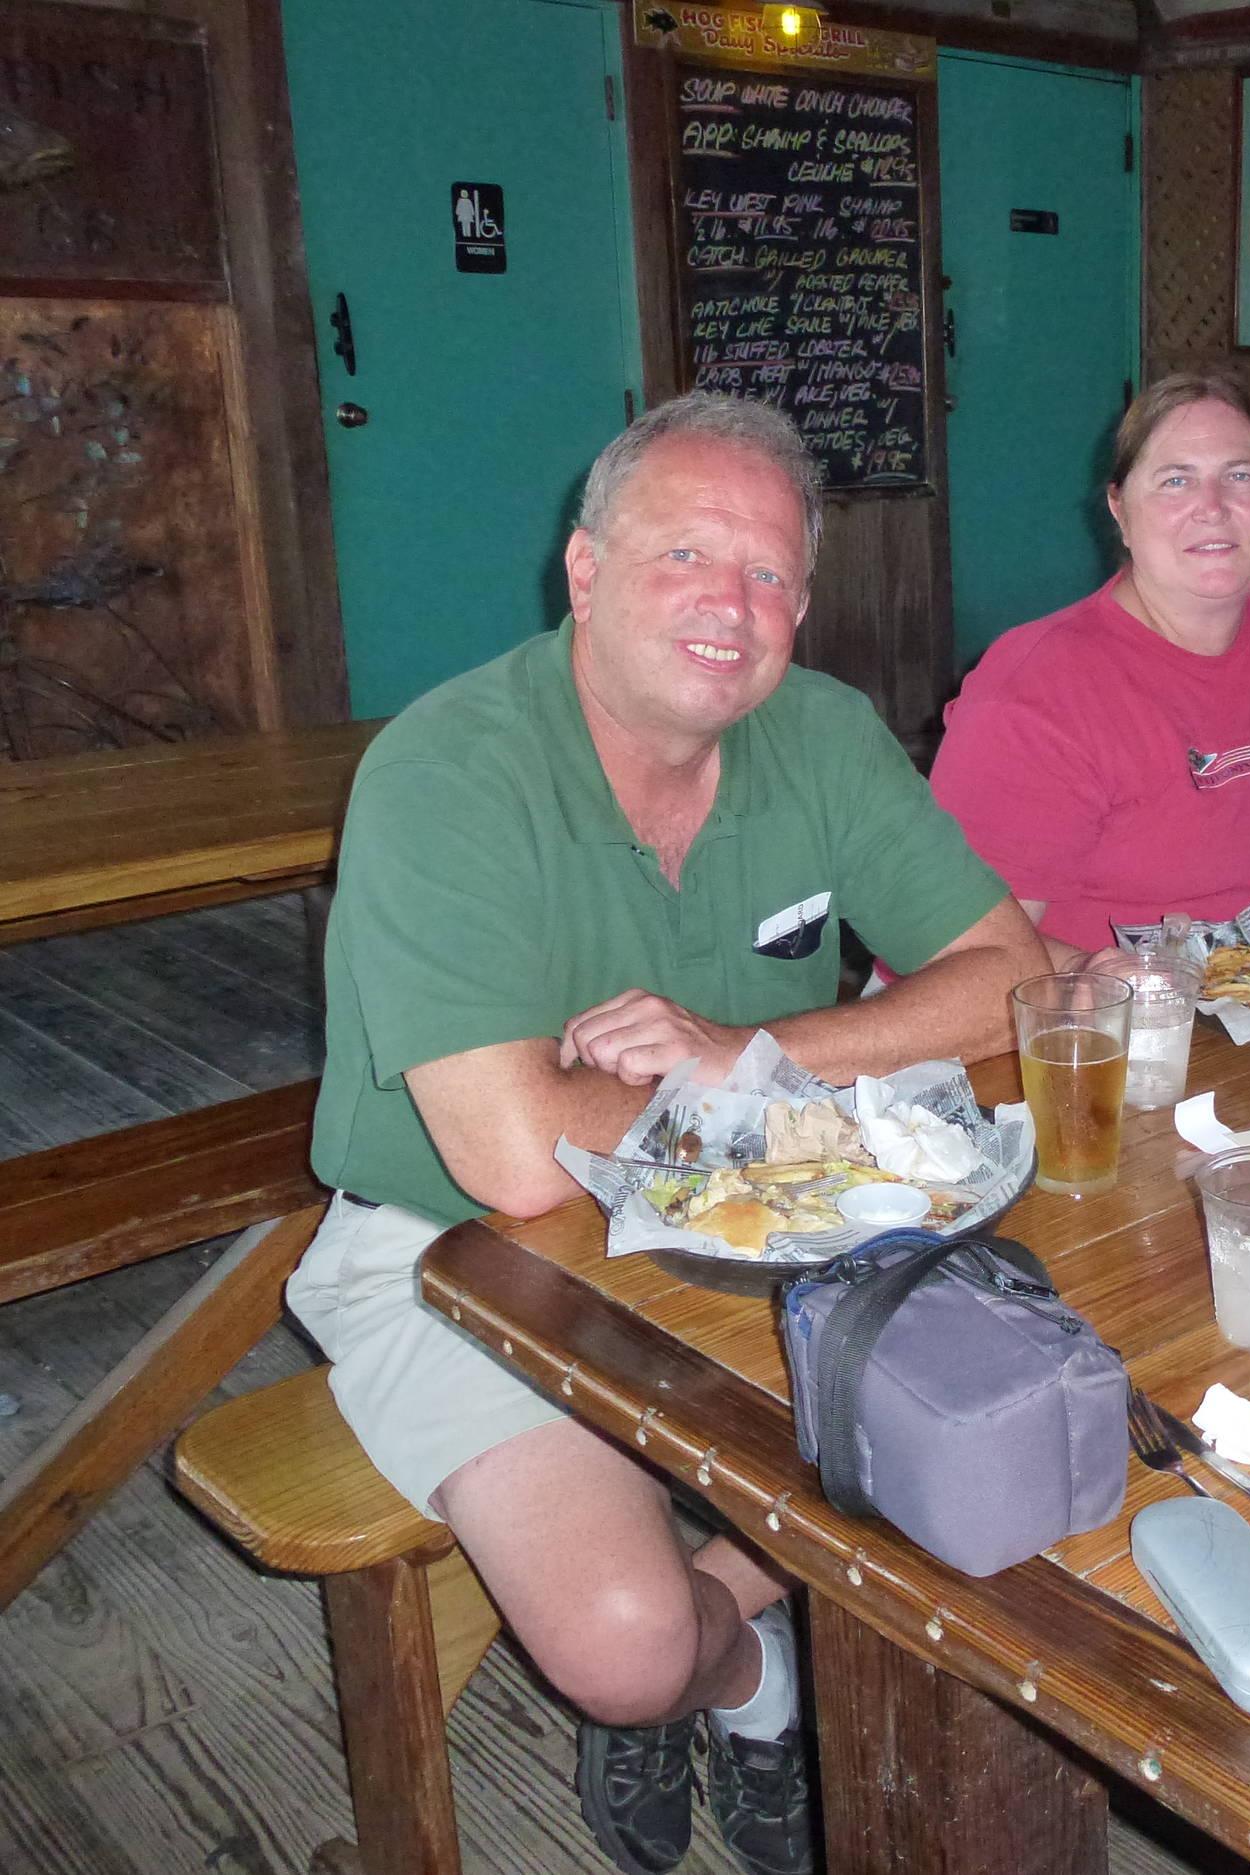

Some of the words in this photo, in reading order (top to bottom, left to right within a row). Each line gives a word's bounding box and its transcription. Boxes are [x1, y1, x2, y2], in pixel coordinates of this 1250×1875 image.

[681, 6, 725, 30] HOG
[833, 129, 911, 154] SCALLOPS
[684, 187, 723, 212] KEY
[729, 192, 776, 212] WEST
[466, 246, 495, 256] WOMEN
[755, 245, 826, 272] GRILLED
[836, 247, 908, 269] GROUPER
[693, 320, 730, 340] KEY
[803, 407, 868, 431] DINNER
